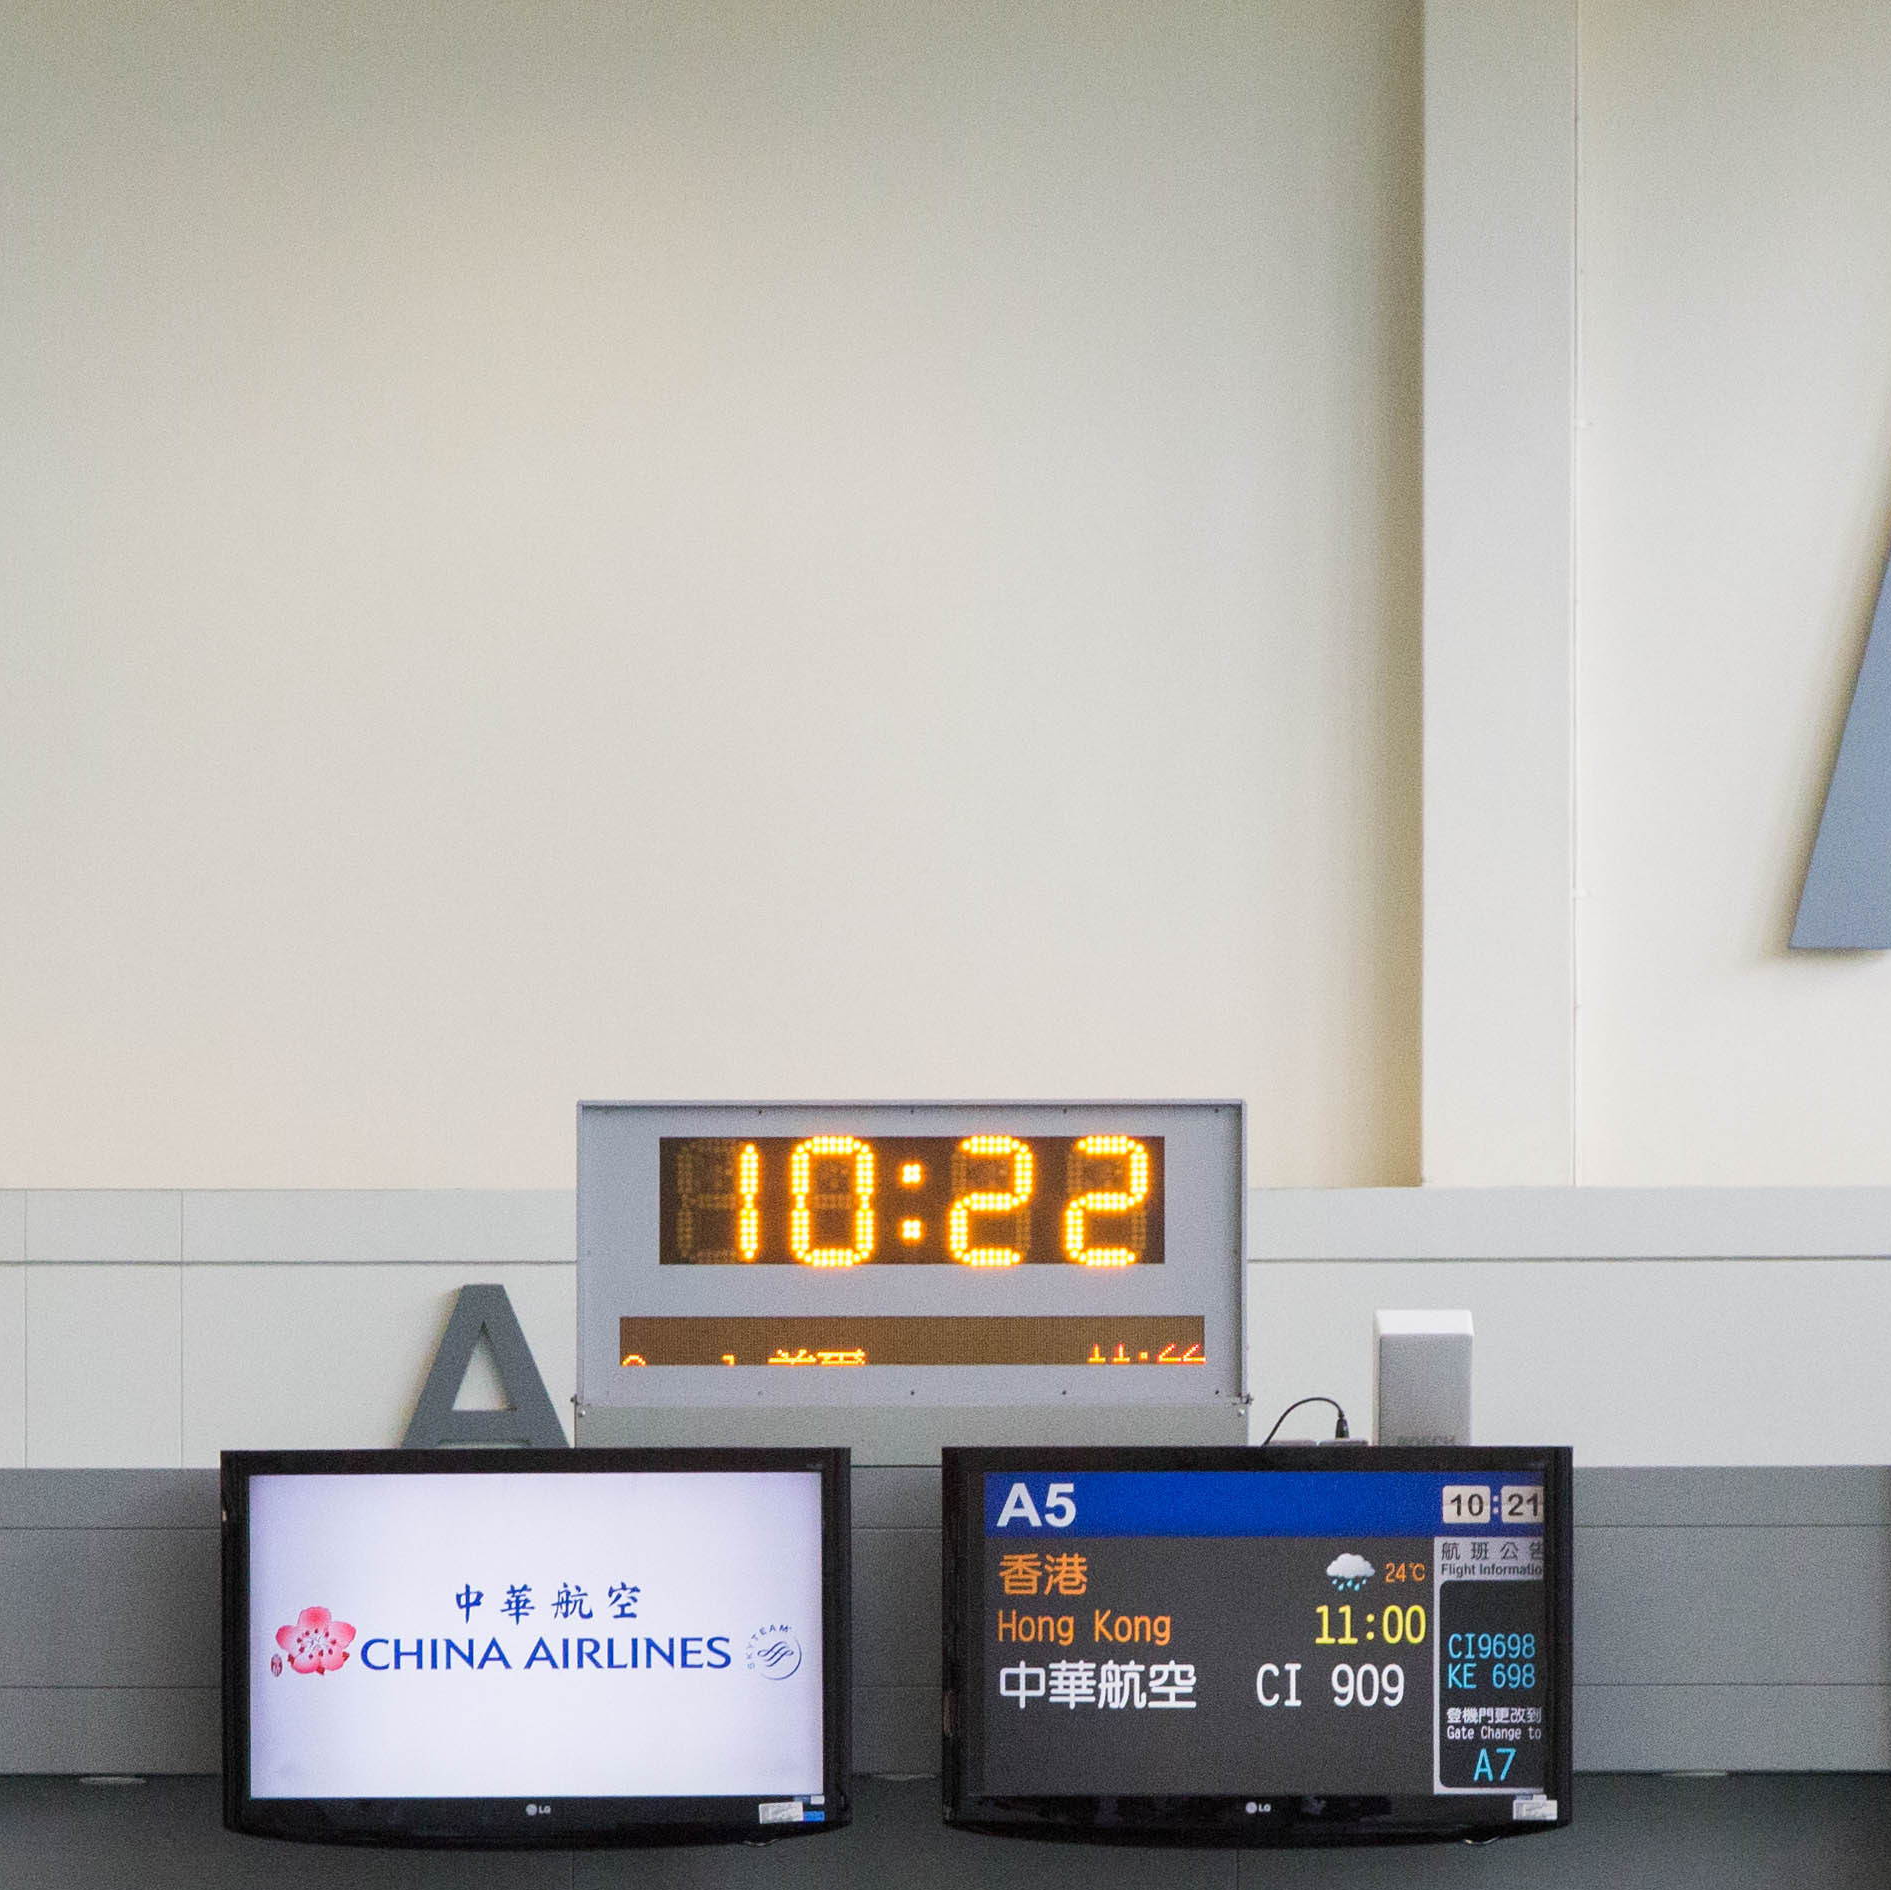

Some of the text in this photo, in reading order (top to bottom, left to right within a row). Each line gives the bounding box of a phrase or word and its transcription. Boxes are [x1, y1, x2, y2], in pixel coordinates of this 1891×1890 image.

[738, 1135, 1149, 1267] 10:22
[996, 1482, 1076, 1528] A5
[1450, 1492, 1540, 1517] 10:21
[999, 1552, 1088, 1597] 香港
[1441, 1563, 1543, 1578] Flight Informatio
[455, 1582, 641, 1624] 中華航空
[998, 1609, 1172, 1646] Hong Kong
[1314, 1604, 1427, 1645] 11:00
[360, 1636, 732, 1671] CHINA AIRLINES
[1448, 1633, 1536, 1660] CI9698
[999, 1659, 1197, 1710] 中華航空
[1255, 1662, 1406, 1708] CI 909
[1447, 1663, 1536, 1689] KE 698
[1446, 1725, 1542, 1741] Gate Change to
[1473, 1747, 1517, 1782] A7
